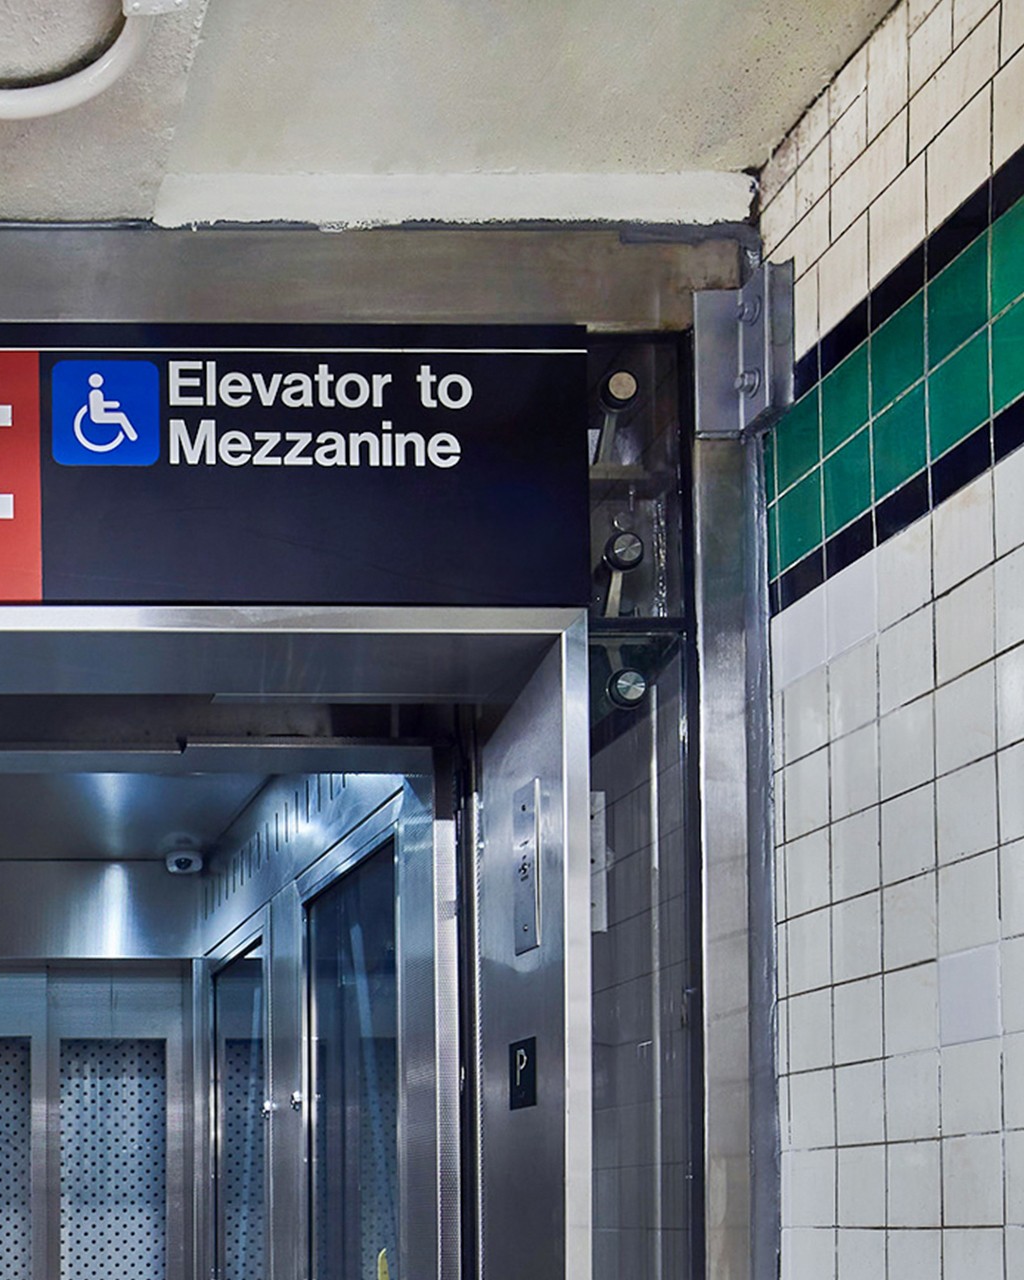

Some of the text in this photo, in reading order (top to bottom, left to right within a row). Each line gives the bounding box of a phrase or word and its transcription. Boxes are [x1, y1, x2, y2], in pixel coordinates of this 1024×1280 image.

[167, 360, 473, 409] Elevator to
[167, 420, 462, 468] Mezzanine
